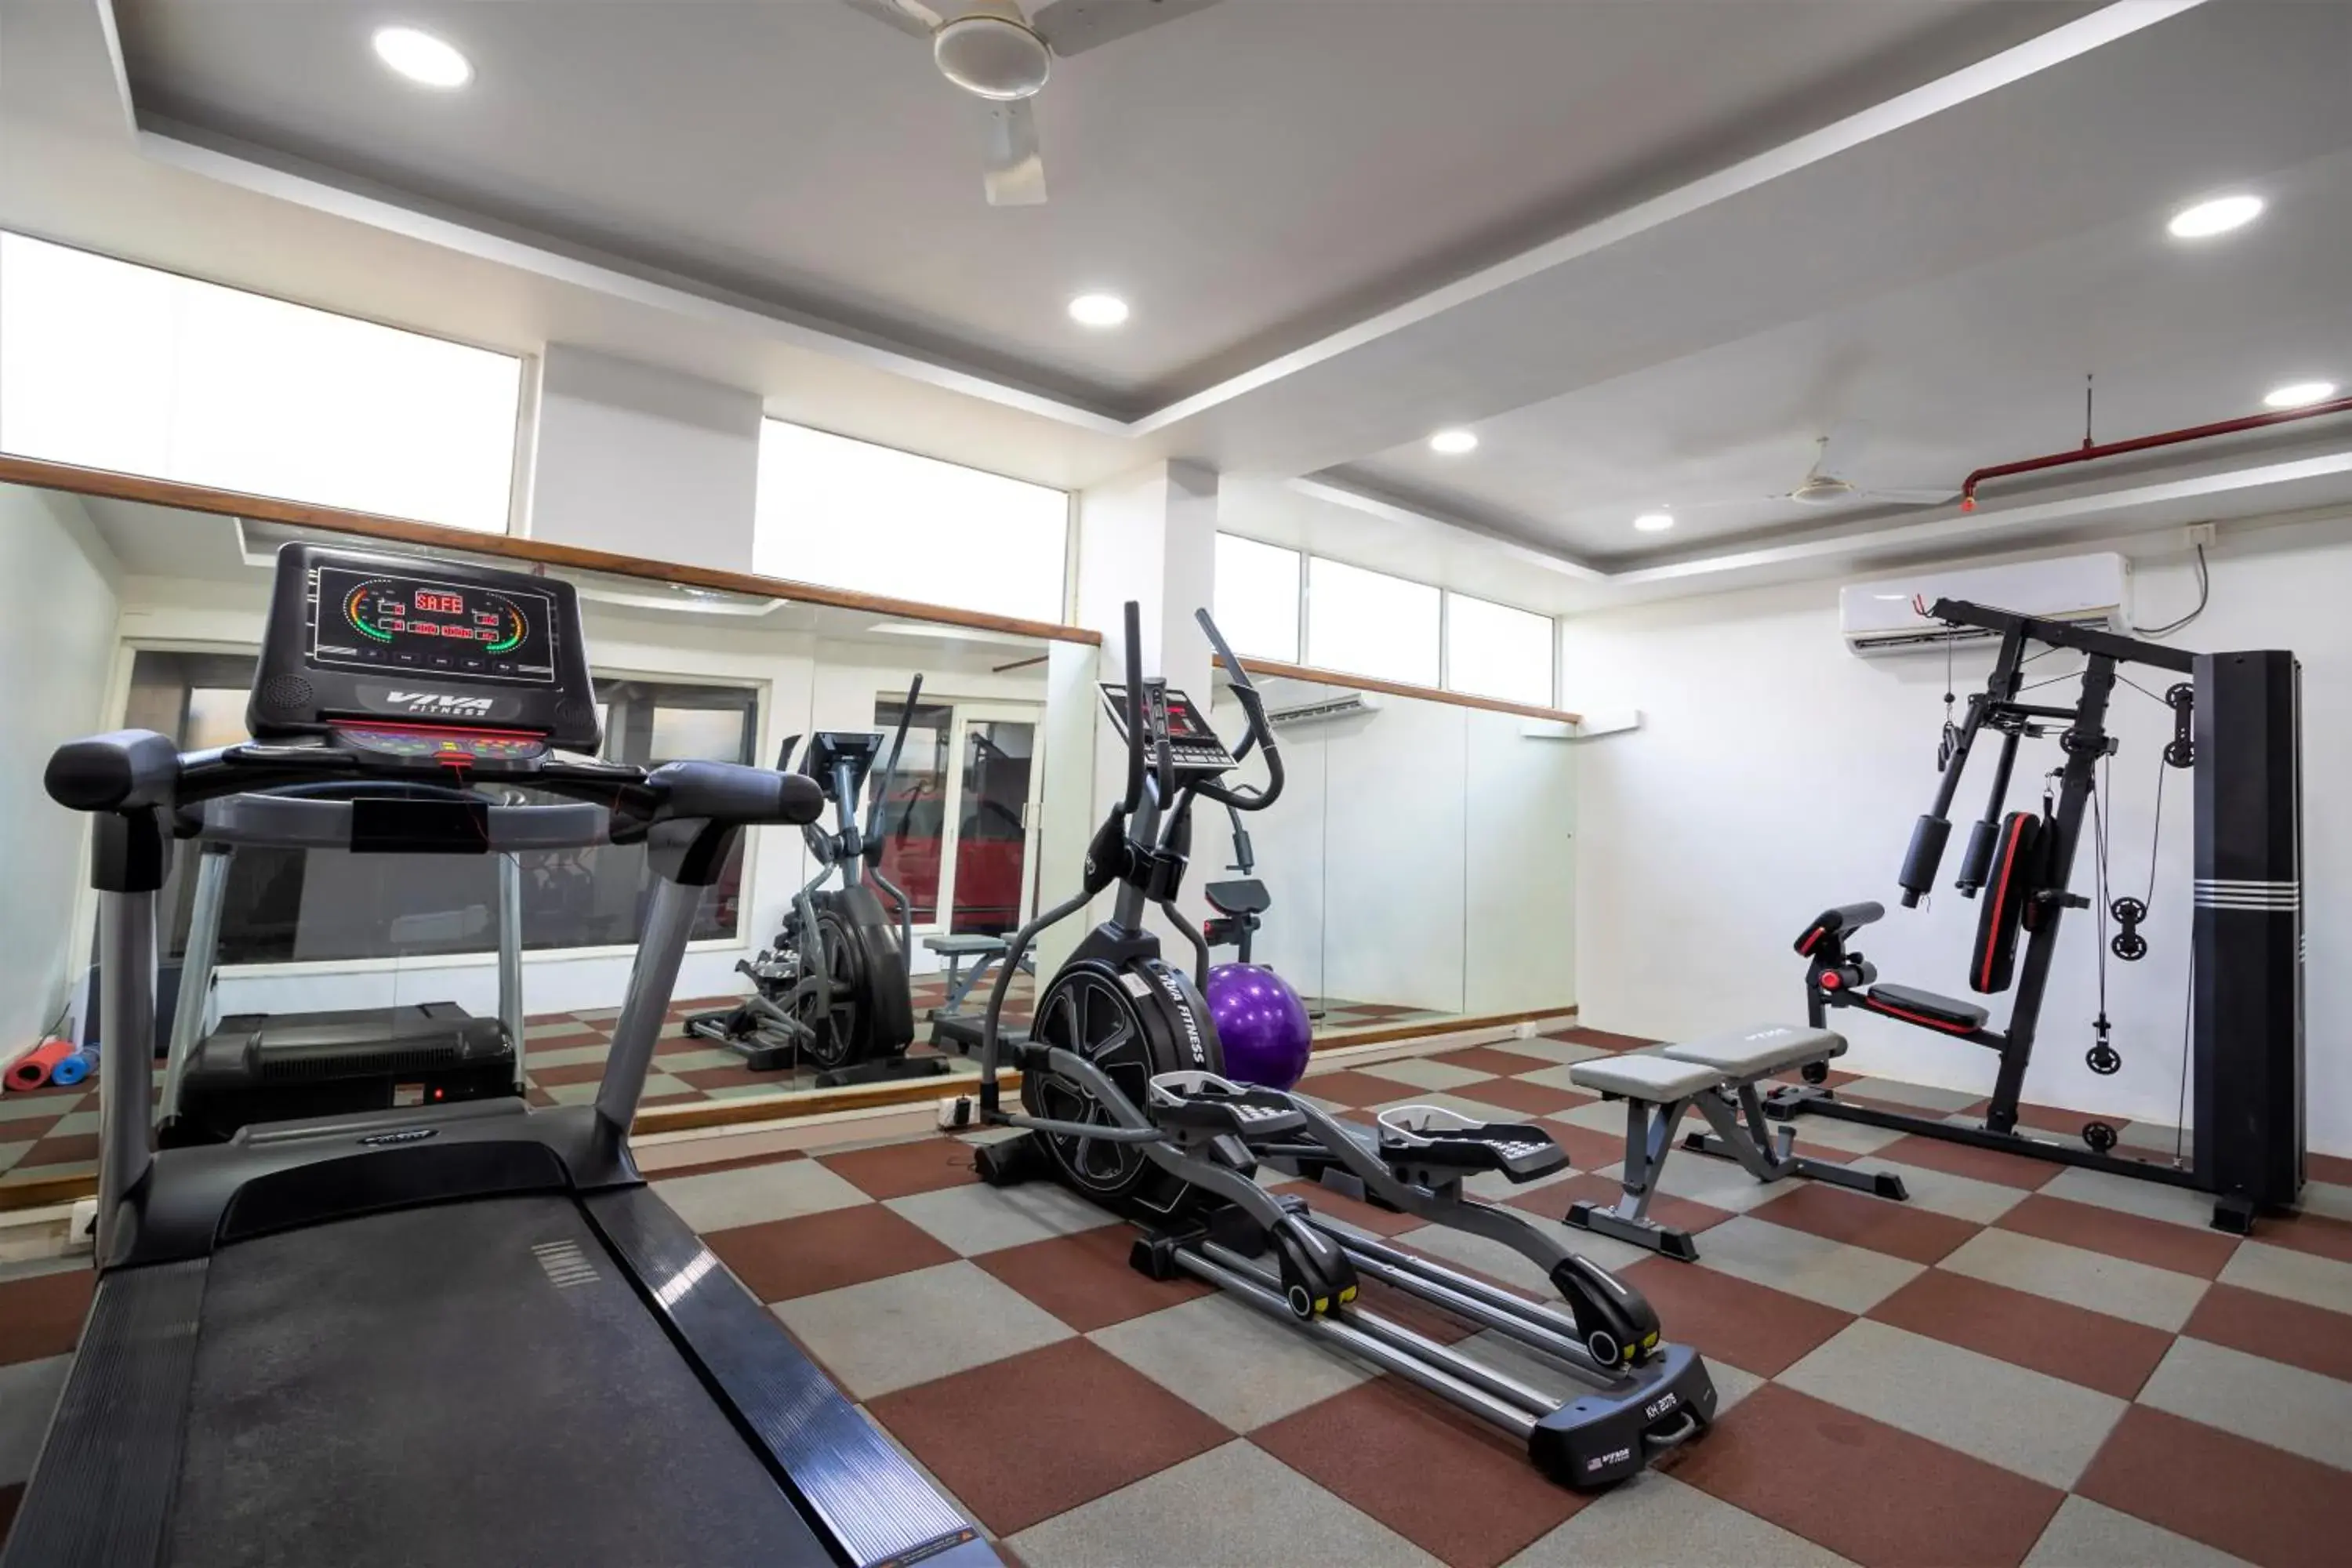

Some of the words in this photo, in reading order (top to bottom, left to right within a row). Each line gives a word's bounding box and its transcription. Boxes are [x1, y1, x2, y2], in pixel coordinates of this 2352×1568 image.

[417, 593, 463, 612] SAFE
[387, 691, 493, 709] VIVA
[408, 705, 487, 716] FITNESS
[1177, 1004, 1205, 1063] FITNESS
